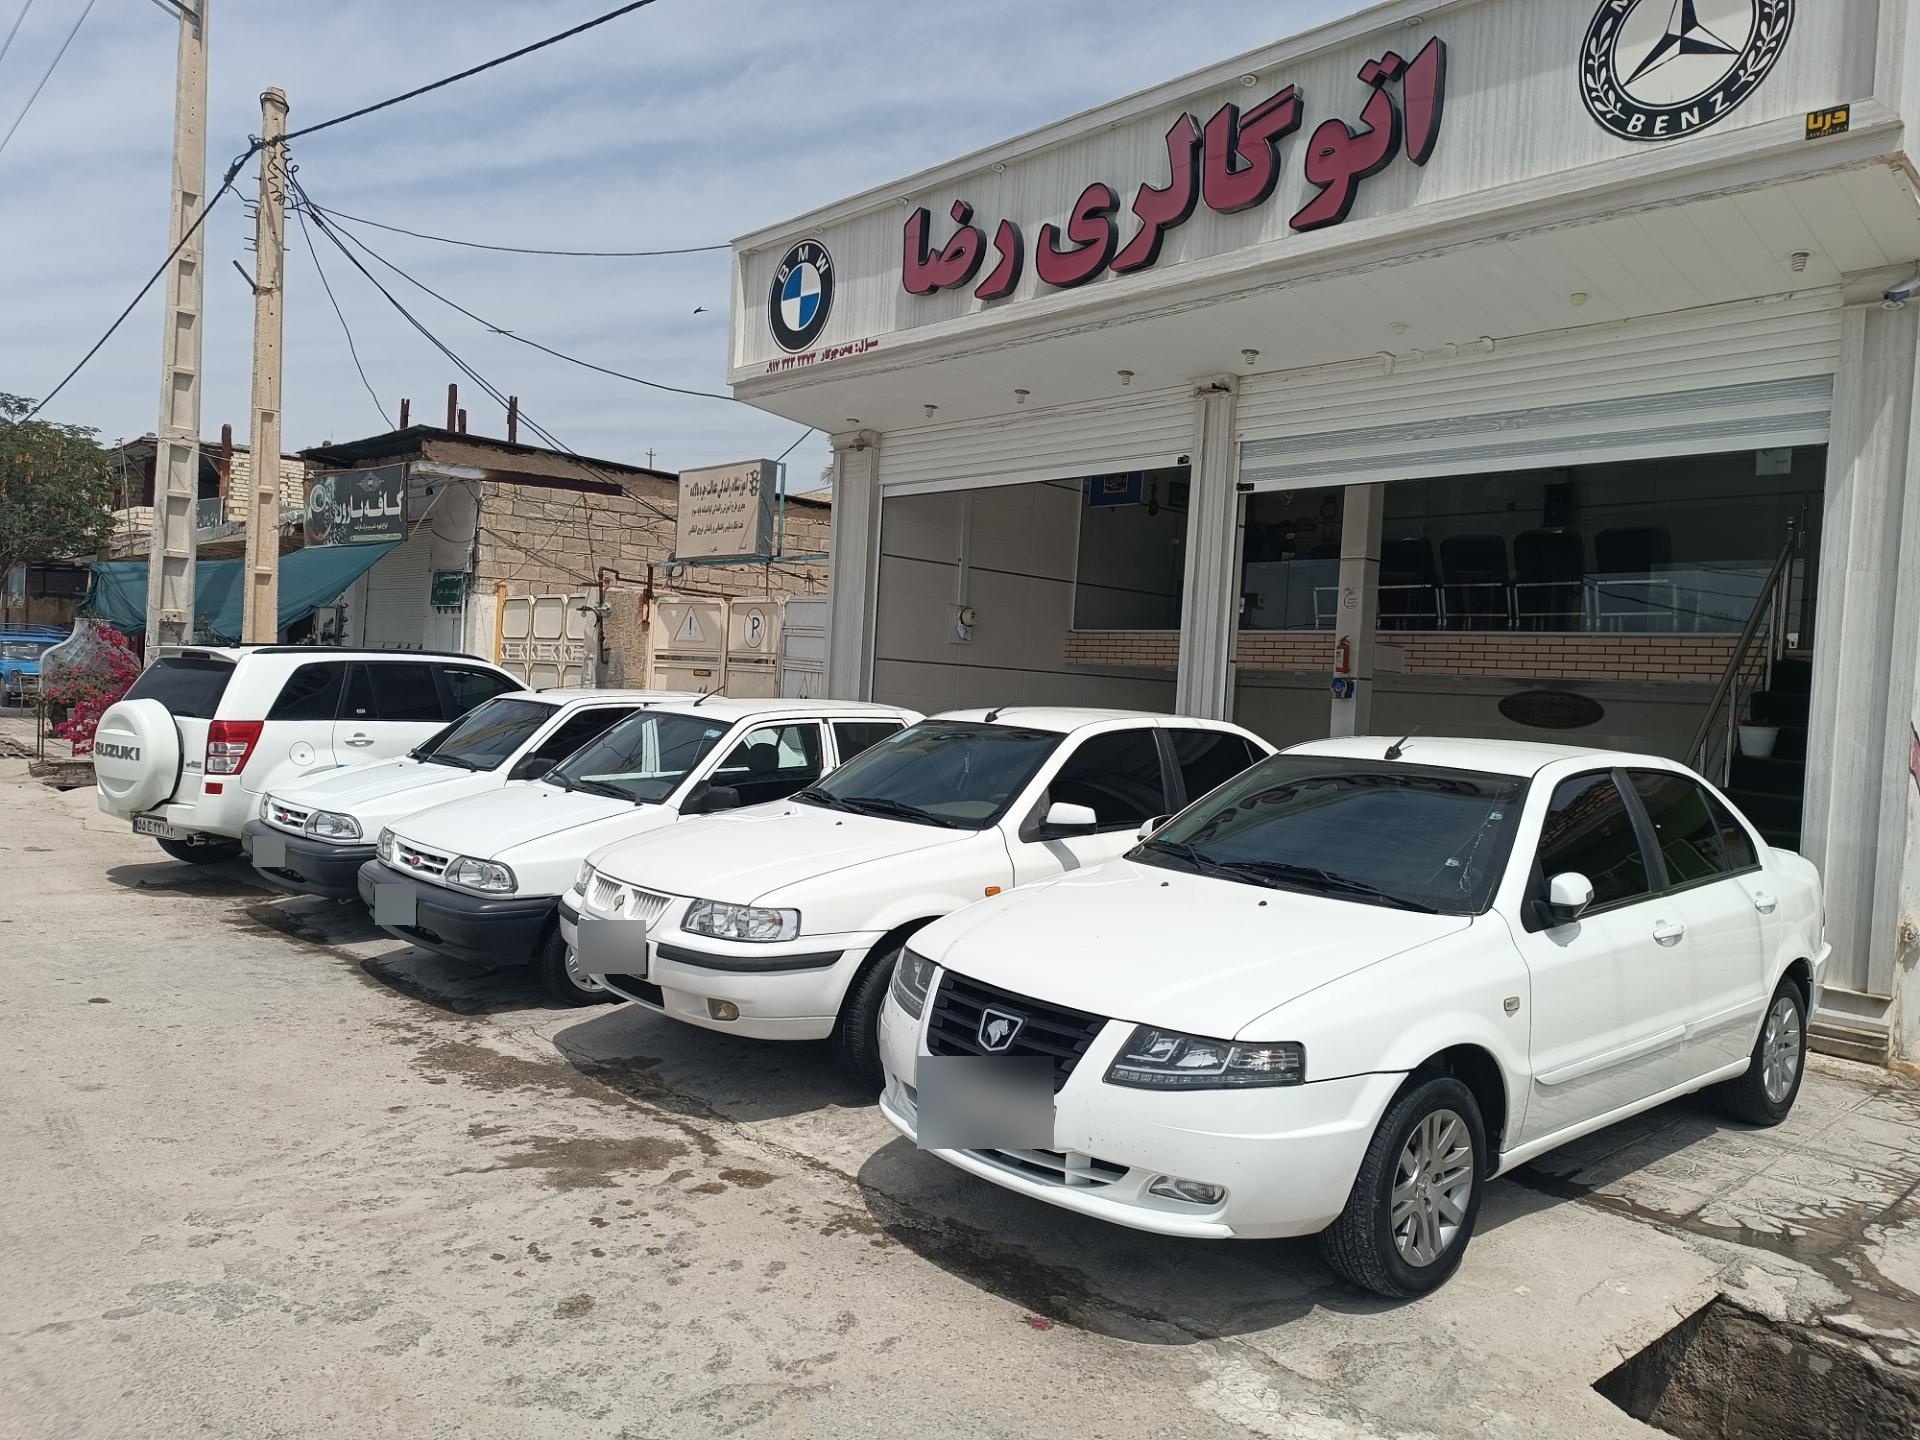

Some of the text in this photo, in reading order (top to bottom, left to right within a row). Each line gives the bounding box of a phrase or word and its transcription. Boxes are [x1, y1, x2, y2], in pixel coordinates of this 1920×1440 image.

[1626, 91, 1731, 136] BENZ
[902, 35, 1447, 300] اتو گالری رضا
[777, 247, 829, 284] BMW
[364, 490, 404, 518] کافه
[95, 741, 140, 761] SUZUKI
